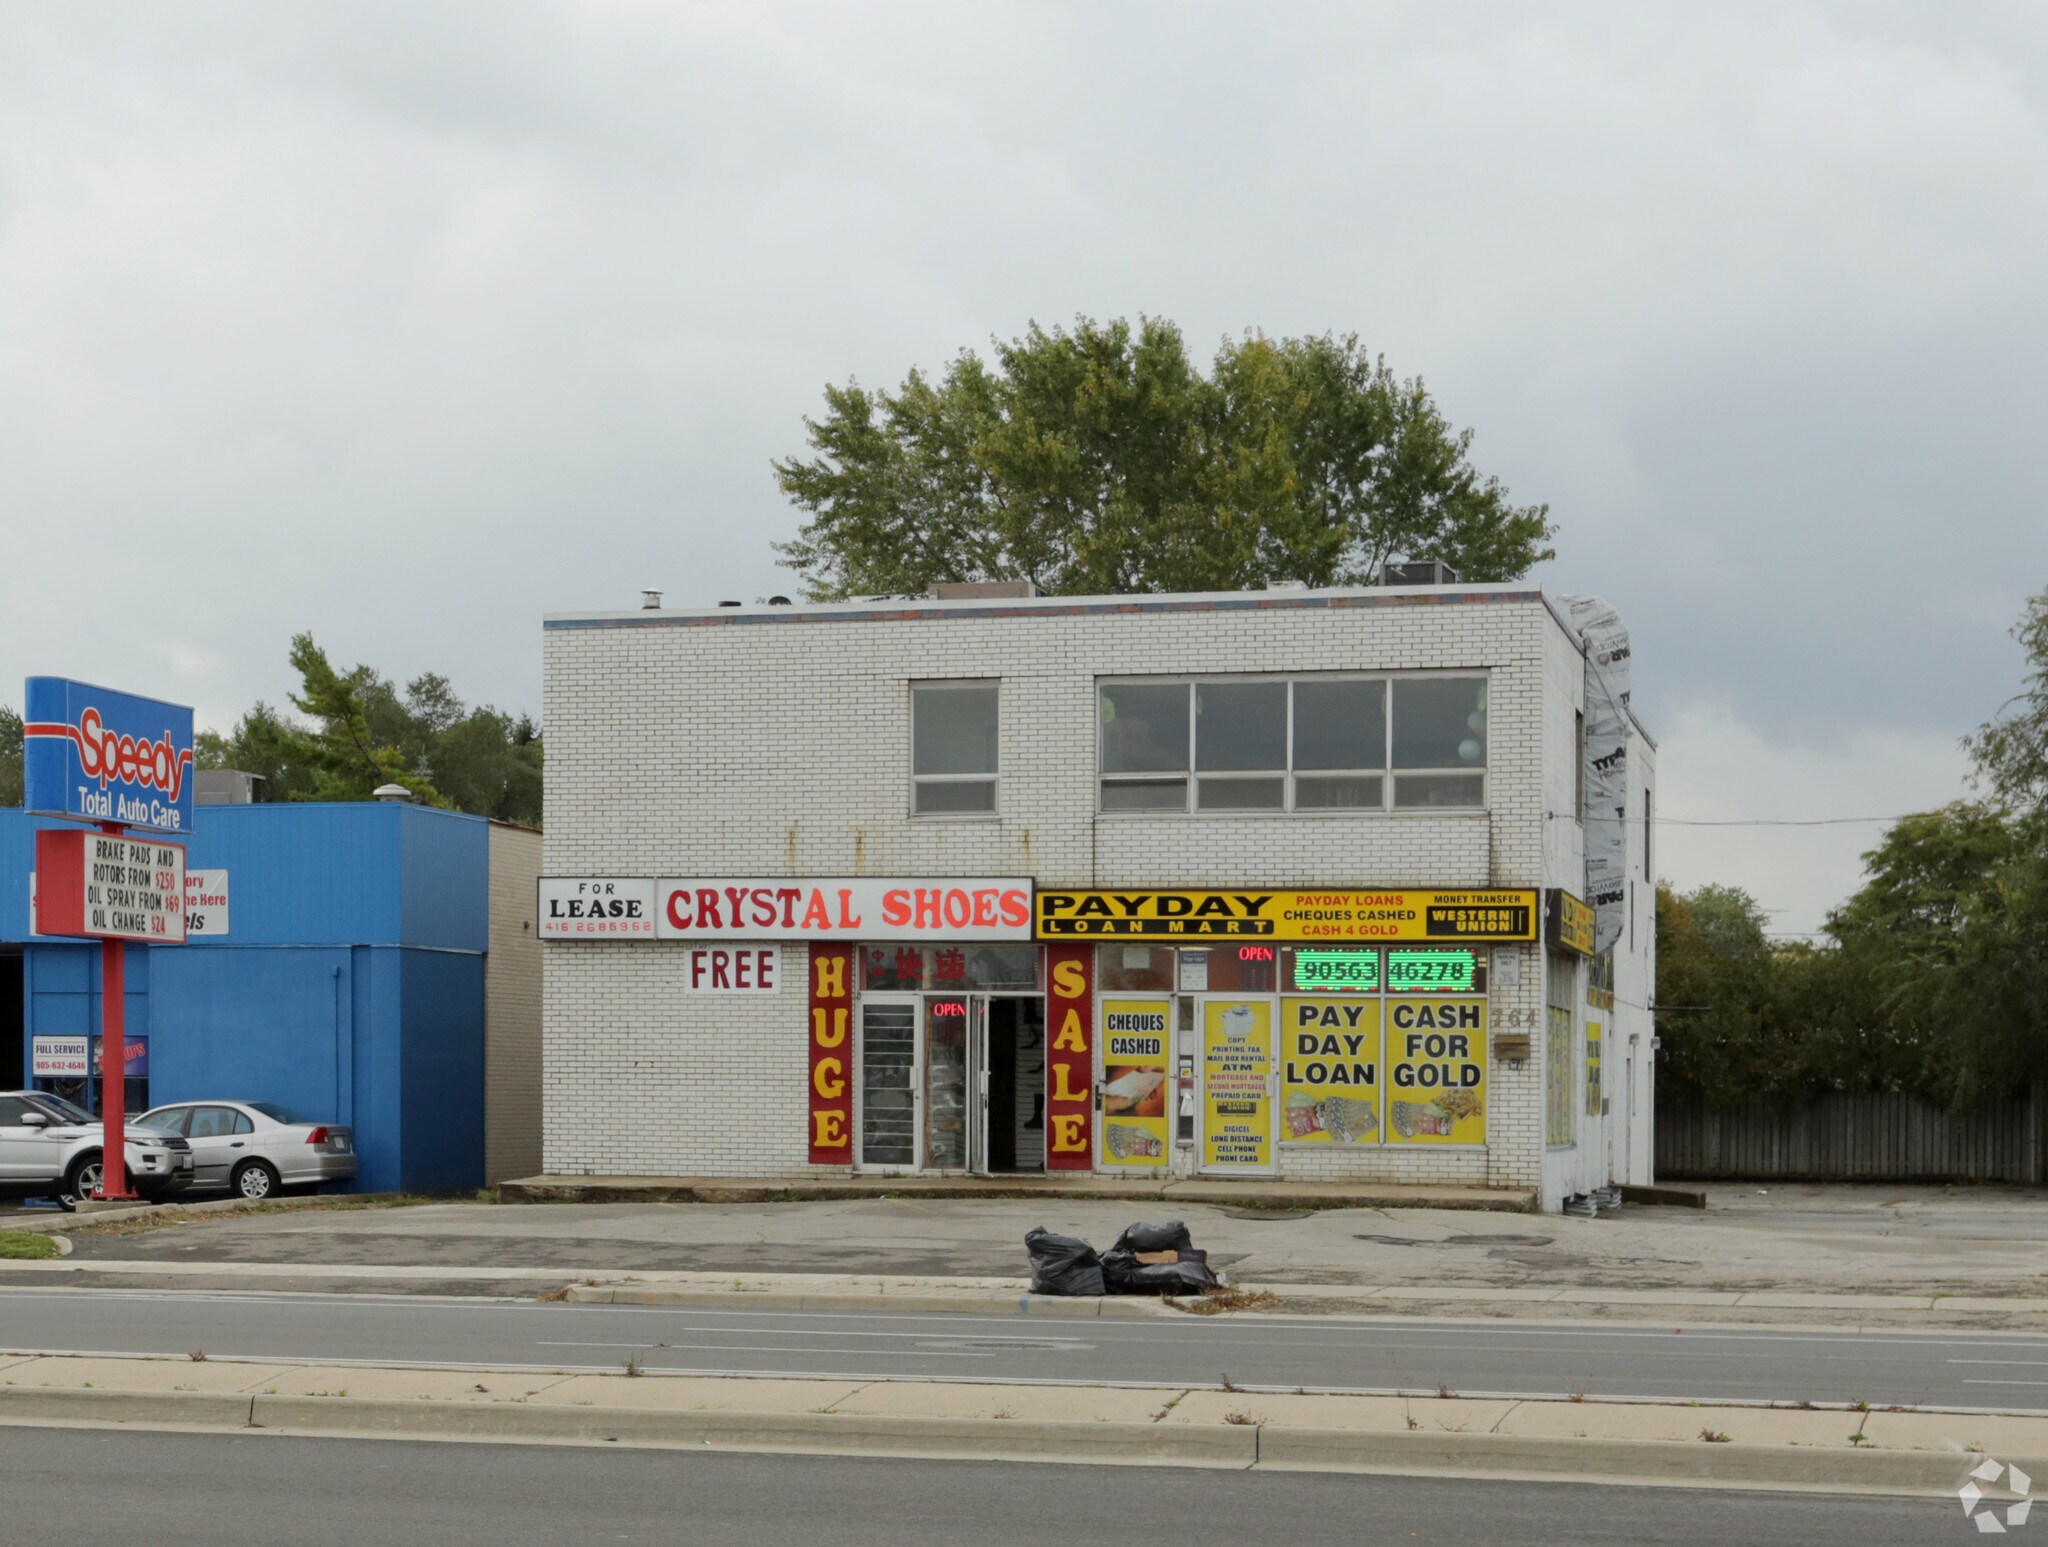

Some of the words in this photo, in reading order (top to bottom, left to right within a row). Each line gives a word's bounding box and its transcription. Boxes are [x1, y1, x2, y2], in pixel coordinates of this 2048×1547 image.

[80, 706, 189, 803] Speedy
[78, 786, 112, 817] Total
[116, 793, 149, 826] Auto
[150, 800, 180, 829] Care
[96, 840, 125, 862] BRAKE
[129, 844, 151, 865] PADS
[156, 849, 174, 867] AND
[93, 863, 126, 884] ROTORS
[128, 868, 151, 887] FROM
[155, 871, 175, 891] $250
[579, 883, 614, 895] FOR
[87, 886, 102, 905] OIL
[107, 888, 137, 909] SPRAY
[138, 891, 162, 911] FROM
[165, 896, 180, 913] $69
[200, 894, 226, 906] Here
[550, 899, 643, 919] LEASE
[666, 886, 861, 930] CRYSTAL
[881, 888, 1030, 929] SHOES
[1043, 895, 1274, 917] PAYDAY
[1296, 896, 1351, 906] PAYDAY
[1355, 896, 1403, 906] LOANS
[1434, 895, 1468, 904] MONEY
[1471, 895, 1521, 904] TRANSFER
[92, 909, 107, 928] OIL
[112, 911, 146, 932] CHANGE
[151, 915, 166, 934] $24
[1283, 910, 1352, 921] CHEQUES
[1357, 910, 1416, 921] CASHED
[1432, 910, 1510, 921] WESTERN
[545, 922, 568, 932] 416
[1050, 920, 1143, 933] LOAN
[1168, 920, 1267, 933] MART
[1302, 925, 1341, 935] CASH
[1346, 925, 1354, 935] 4
[1358, 925, 1398, 935] GOLD
[1456, 921, 1510, 932] UNION
[1239, 947, 1274, 960] OPEN
[692, 950, 774, 989] FREE
[1304, 962, 1377, 980] 90563
[1389, 962, 1464, 980] 46278
[934, 1003, 966, 1017] OPEN
[1299, 1005, 1364, 1027] PAY
[1393, 1004, 1480, 1029] CASH
[1107, 1013, 1164, 1031] CHEQUES
[36, 1045, 52, 1054] FULL
[54, 1045, 85, 1054] SERVICE
[813, 956, 848, 1148] HUGE
[1111, 1038, 1160, 1055] CASHED
[1299, 1034, 1364, 1056] DAY
[1407, 1034, 1468, 1058] FOR
[36, 1061, 86, 1070] 905-632-4646
[1052, 959, 1088, 1152] SALE
[1287, 1063, 1375, 1084] LOAN
[1394, 1063, 1481, 1088] GOLD
